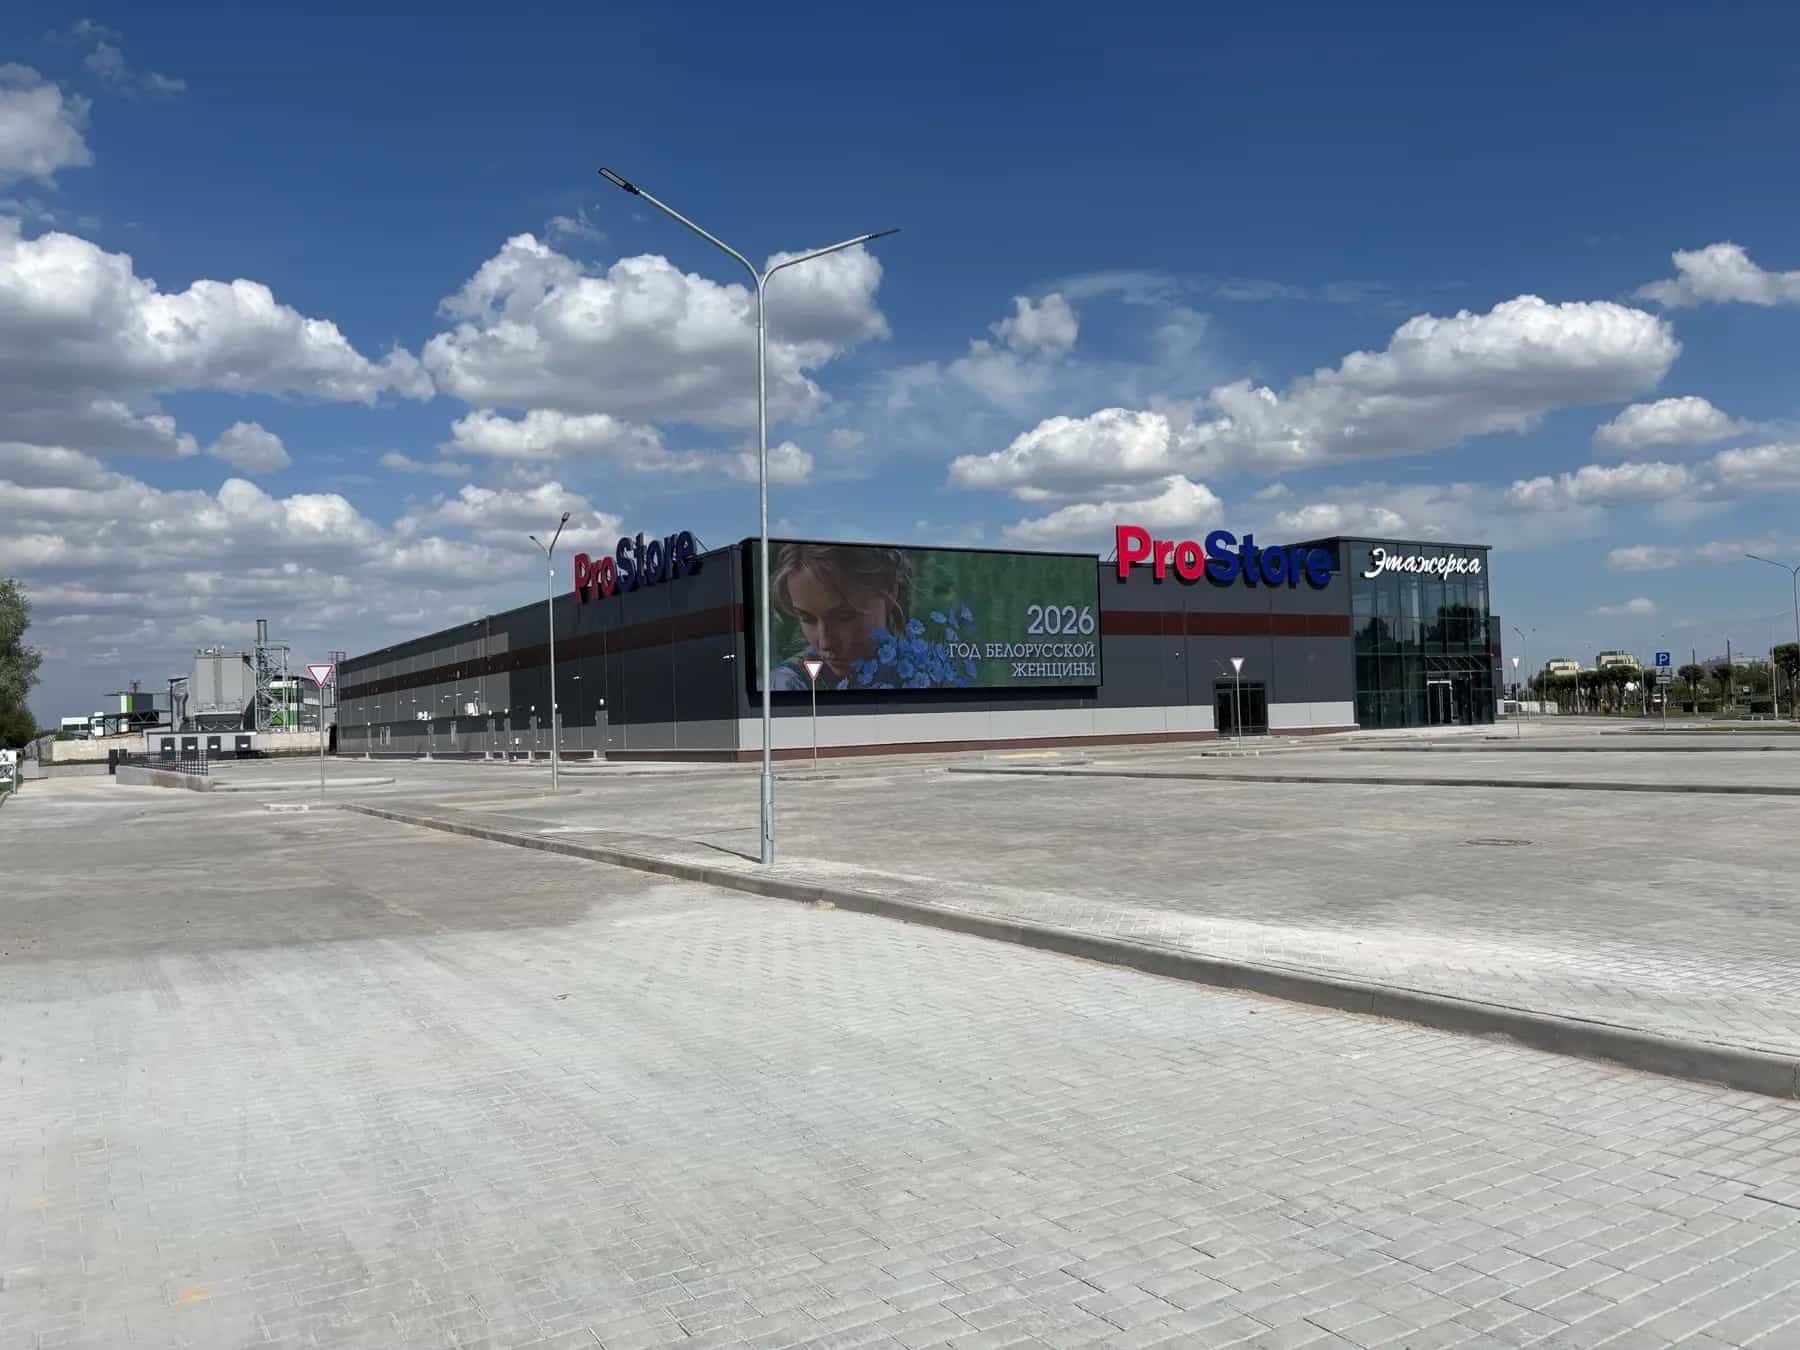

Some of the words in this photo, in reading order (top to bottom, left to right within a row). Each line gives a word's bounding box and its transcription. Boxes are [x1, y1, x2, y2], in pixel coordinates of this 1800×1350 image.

[574, 531, 696, 604] ProStore
[1117, 525, 1332, 588] ProStore
[1364, 547, 1482, 580] Этажерка
[1027, 605, 1095, 634] 2026
[949, 643, 981, 659] ГОД
[985, 641, 1095, 658] БЕЛОРУССКОЙ
[1011, 662, 1096, 678] ЖЕНЩИНЫ
